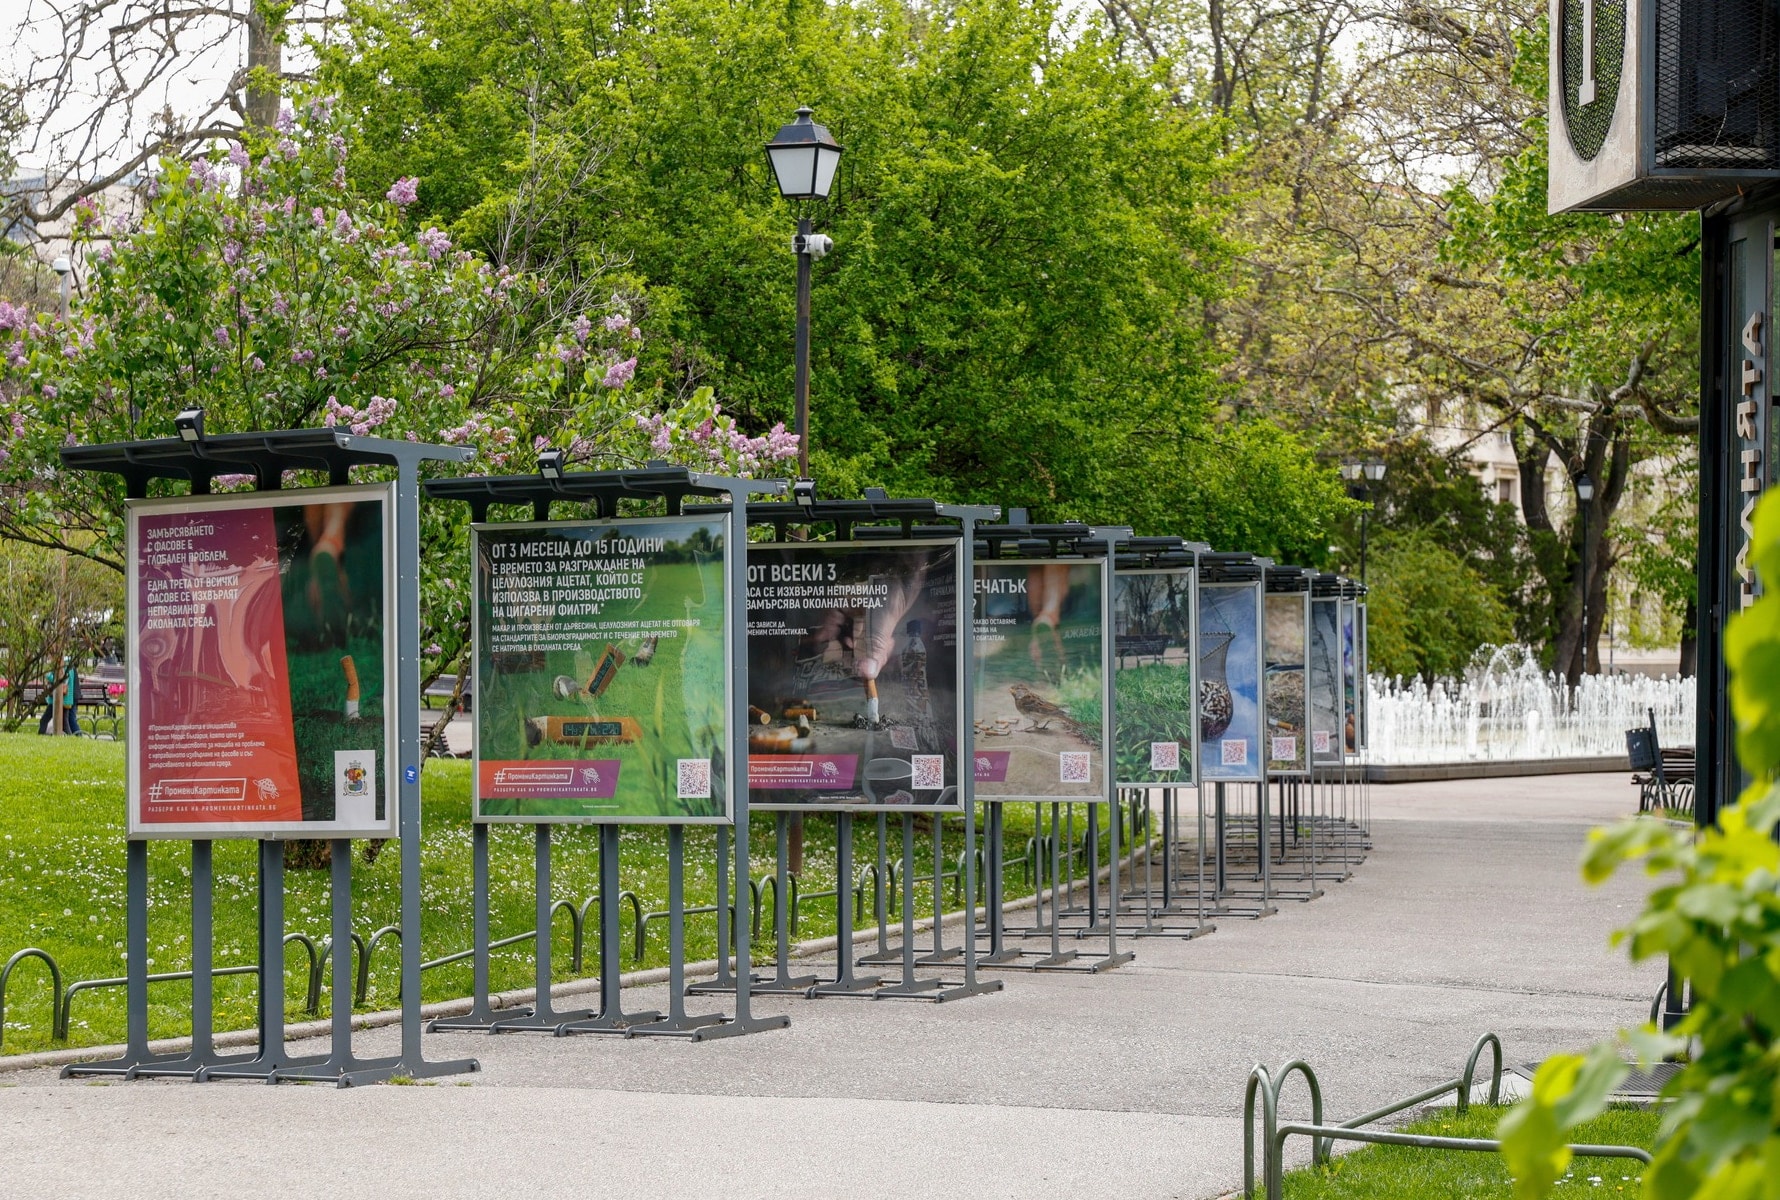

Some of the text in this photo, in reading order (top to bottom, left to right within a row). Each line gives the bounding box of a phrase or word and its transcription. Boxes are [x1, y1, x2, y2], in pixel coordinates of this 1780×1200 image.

[1736, 311, 1762, 617] ТАЛНЯТА
[147, 525, 214, 539] ЗАМЪРСЯВАНЕТО
[147, 540, 192, 552] С ФАСОВЕ Е
[492, 538, 664, 558] ОТ 3 МЕСЕЦА ДО 15 ГОДИНИ
[148, 550, 229, 565] ГЛОБАЛЕН ПРОБЛЕМ.
[492, 558, 645, 574] Е ВРЕМЕТО ЗА РАЗГРАЖДАНЕ НА
[748, 563, 836, 582] ОТ ВСЕКИ 3
[148, 576, 238, 592] ЕДНА ТРЕТА ОТ ВСИЧКИ
[492, 571, 643, 590] ЦЕЛУЛОЗНИЯ АЦЕТАТ, КОЙТО СЕ
[974, 578, 1027, 594] ЕЧАТЪК
[147, 589, 238, 604] ФАСОВЕ СЕ ИЗХВЪРЛЯТ
[492, 587, 641, 603] ИЗПОЛЗВА В ПРОИЗВОДСТВОТО
[746, 584, 888, 597] АСА СЕ ИЗХВЪРЛЯ НЕПРАВИЛНО
[148, 604, 206, 616] НЕПРАВИЛНО В
[746, 598, 800, 610] ЗАМЪРСЯВА
[802, 597, 849, 609] ОКОЛНАТА
[492, 606, 504, 618] НА
[507, 605, 555, 618] ЦИГАРЕНИ
[148, 617, 215, 629] ОКОЛНАТА СРЕДА.
[640, 620, 661, 628] АЦЕТАТ
